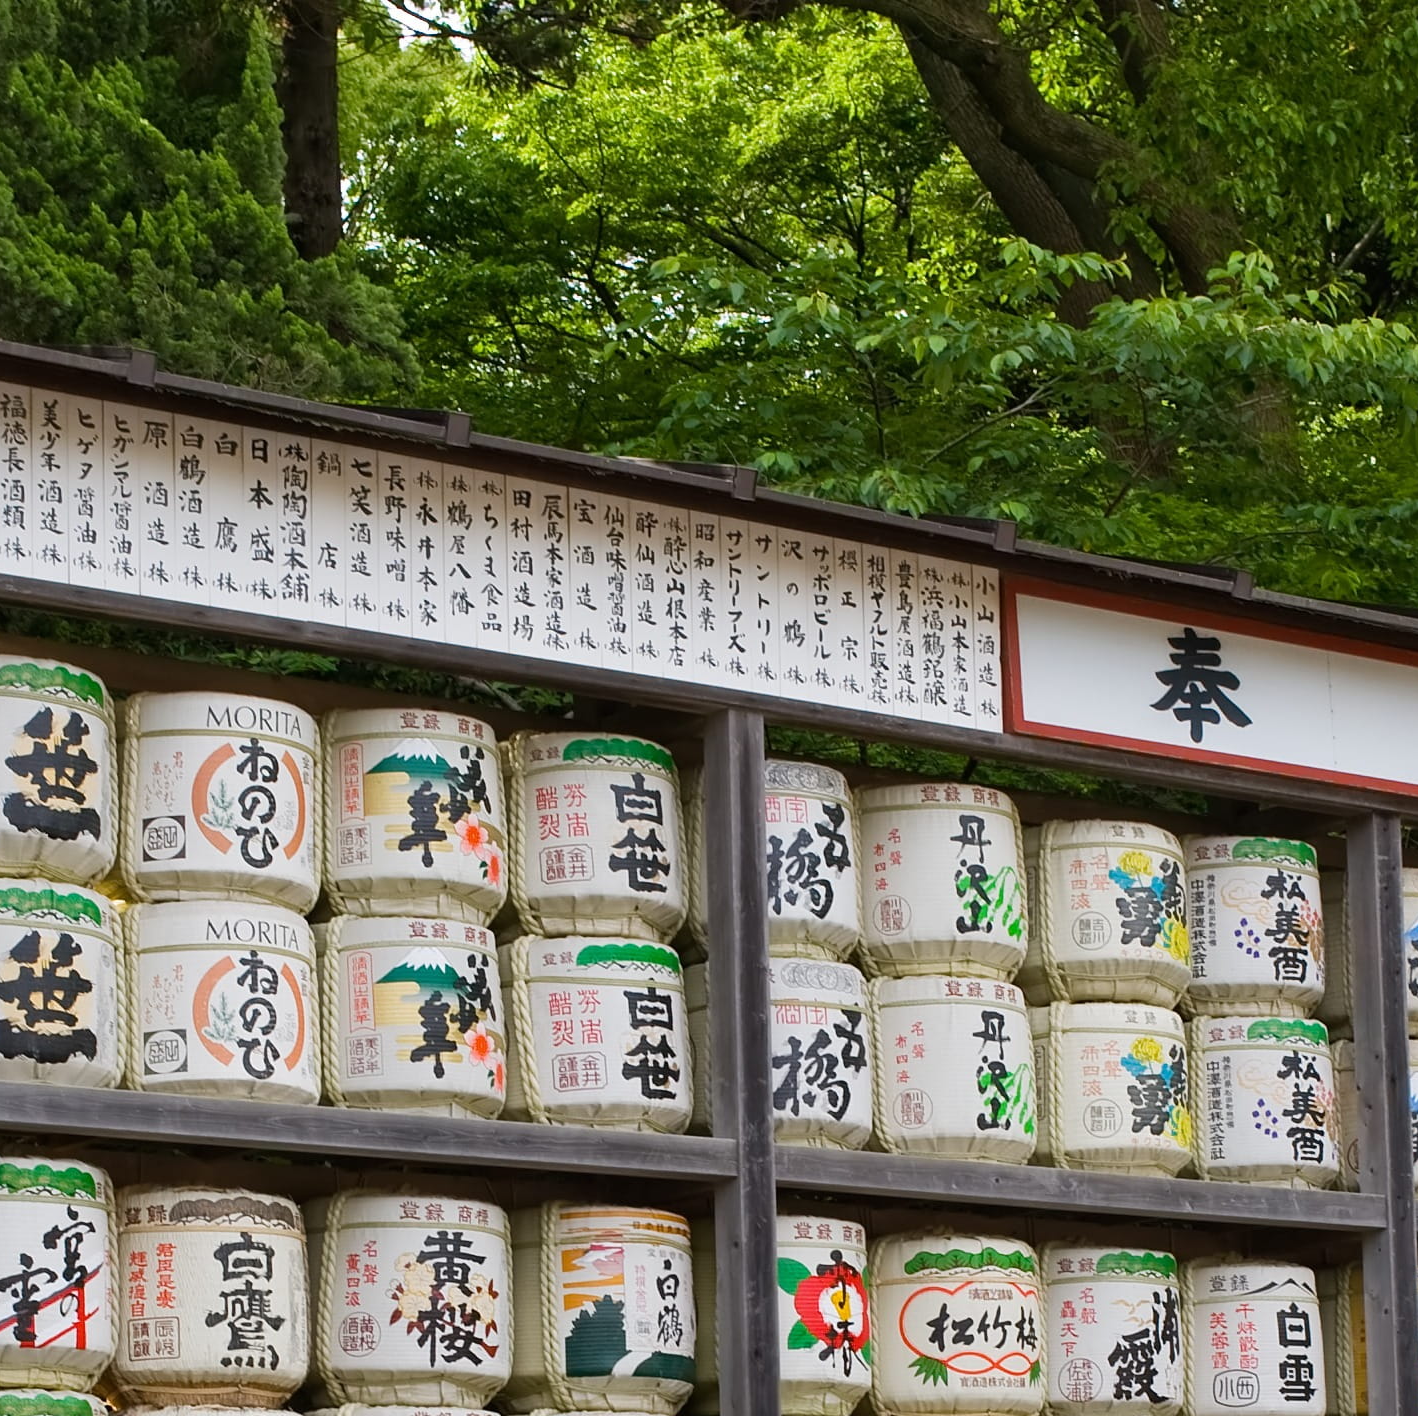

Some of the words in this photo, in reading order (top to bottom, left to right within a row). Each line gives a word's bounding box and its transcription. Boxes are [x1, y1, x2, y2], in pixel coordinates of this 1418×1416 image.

[511, 489, 536, 641] 田村酒造場
[206, 705, 302, 738] MORITA
[236, 738, 279, 869] ねのひ
[951, 814, 991, 934] 丹沢山
[1261, 869, 1309, 984] 松美酉
[206, 919, 298, 950] MORITA
[236, 951, 279, 1079] ねのひ
[973, 1011, 1011, 1131] 丹沢山
[1278, 1051, 1325, 1164] 松美酉
[206, 1233, 286, 1370] 白鷹
[417, 1231, 486, 1368] 黄桜
[656, 1259, 684, 1348] 白鶴
[926, 1303, 1038, 1352] 松竹梅
[1277, 1302, 1317, 1402] 白雪
